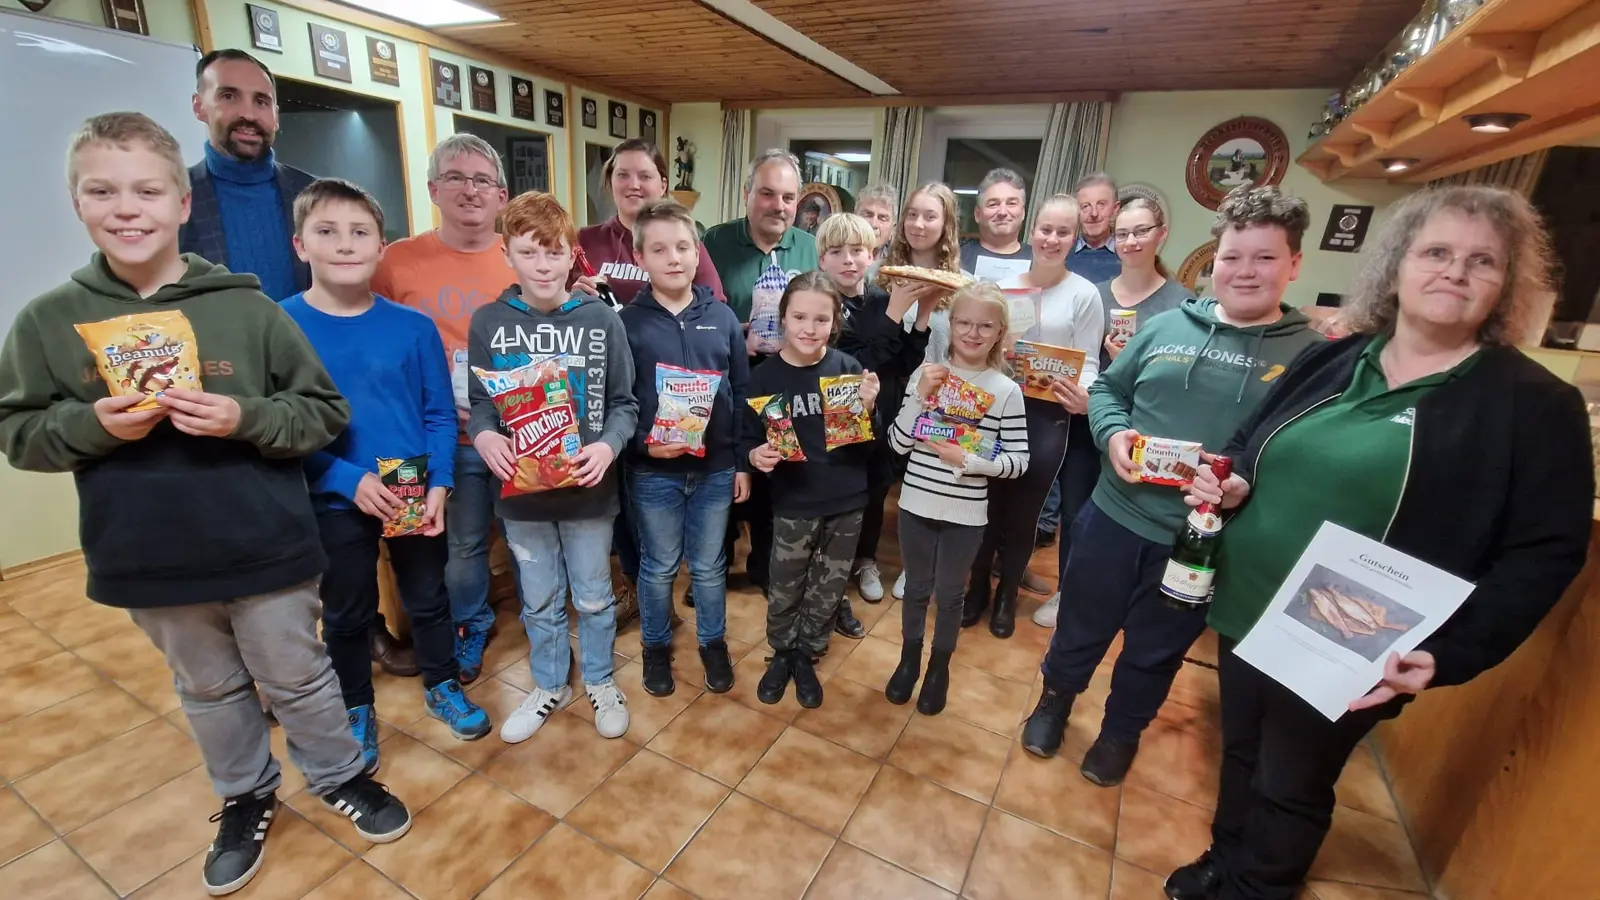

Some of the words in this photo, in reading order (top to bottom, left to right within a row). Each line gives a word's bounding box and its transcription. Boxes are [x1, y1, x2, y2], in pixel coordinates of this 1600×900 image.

[1111, 318, 1130, 327] uplo
[110, 345, 182, 367] peanuts
[1027, 356, 1078, 379] Toffifee
[665, 379, 708, 393] hanuta
[688, 393, 714, 405] MINIS
[517, 409, 569, 451] runchips
[921, 425, 954, 438] MAOAM
[534, 437, 560, 459] Paprika
[1146, 447, 1181, 460] Country
[1359, 553, 1410, 581] Gutschein
